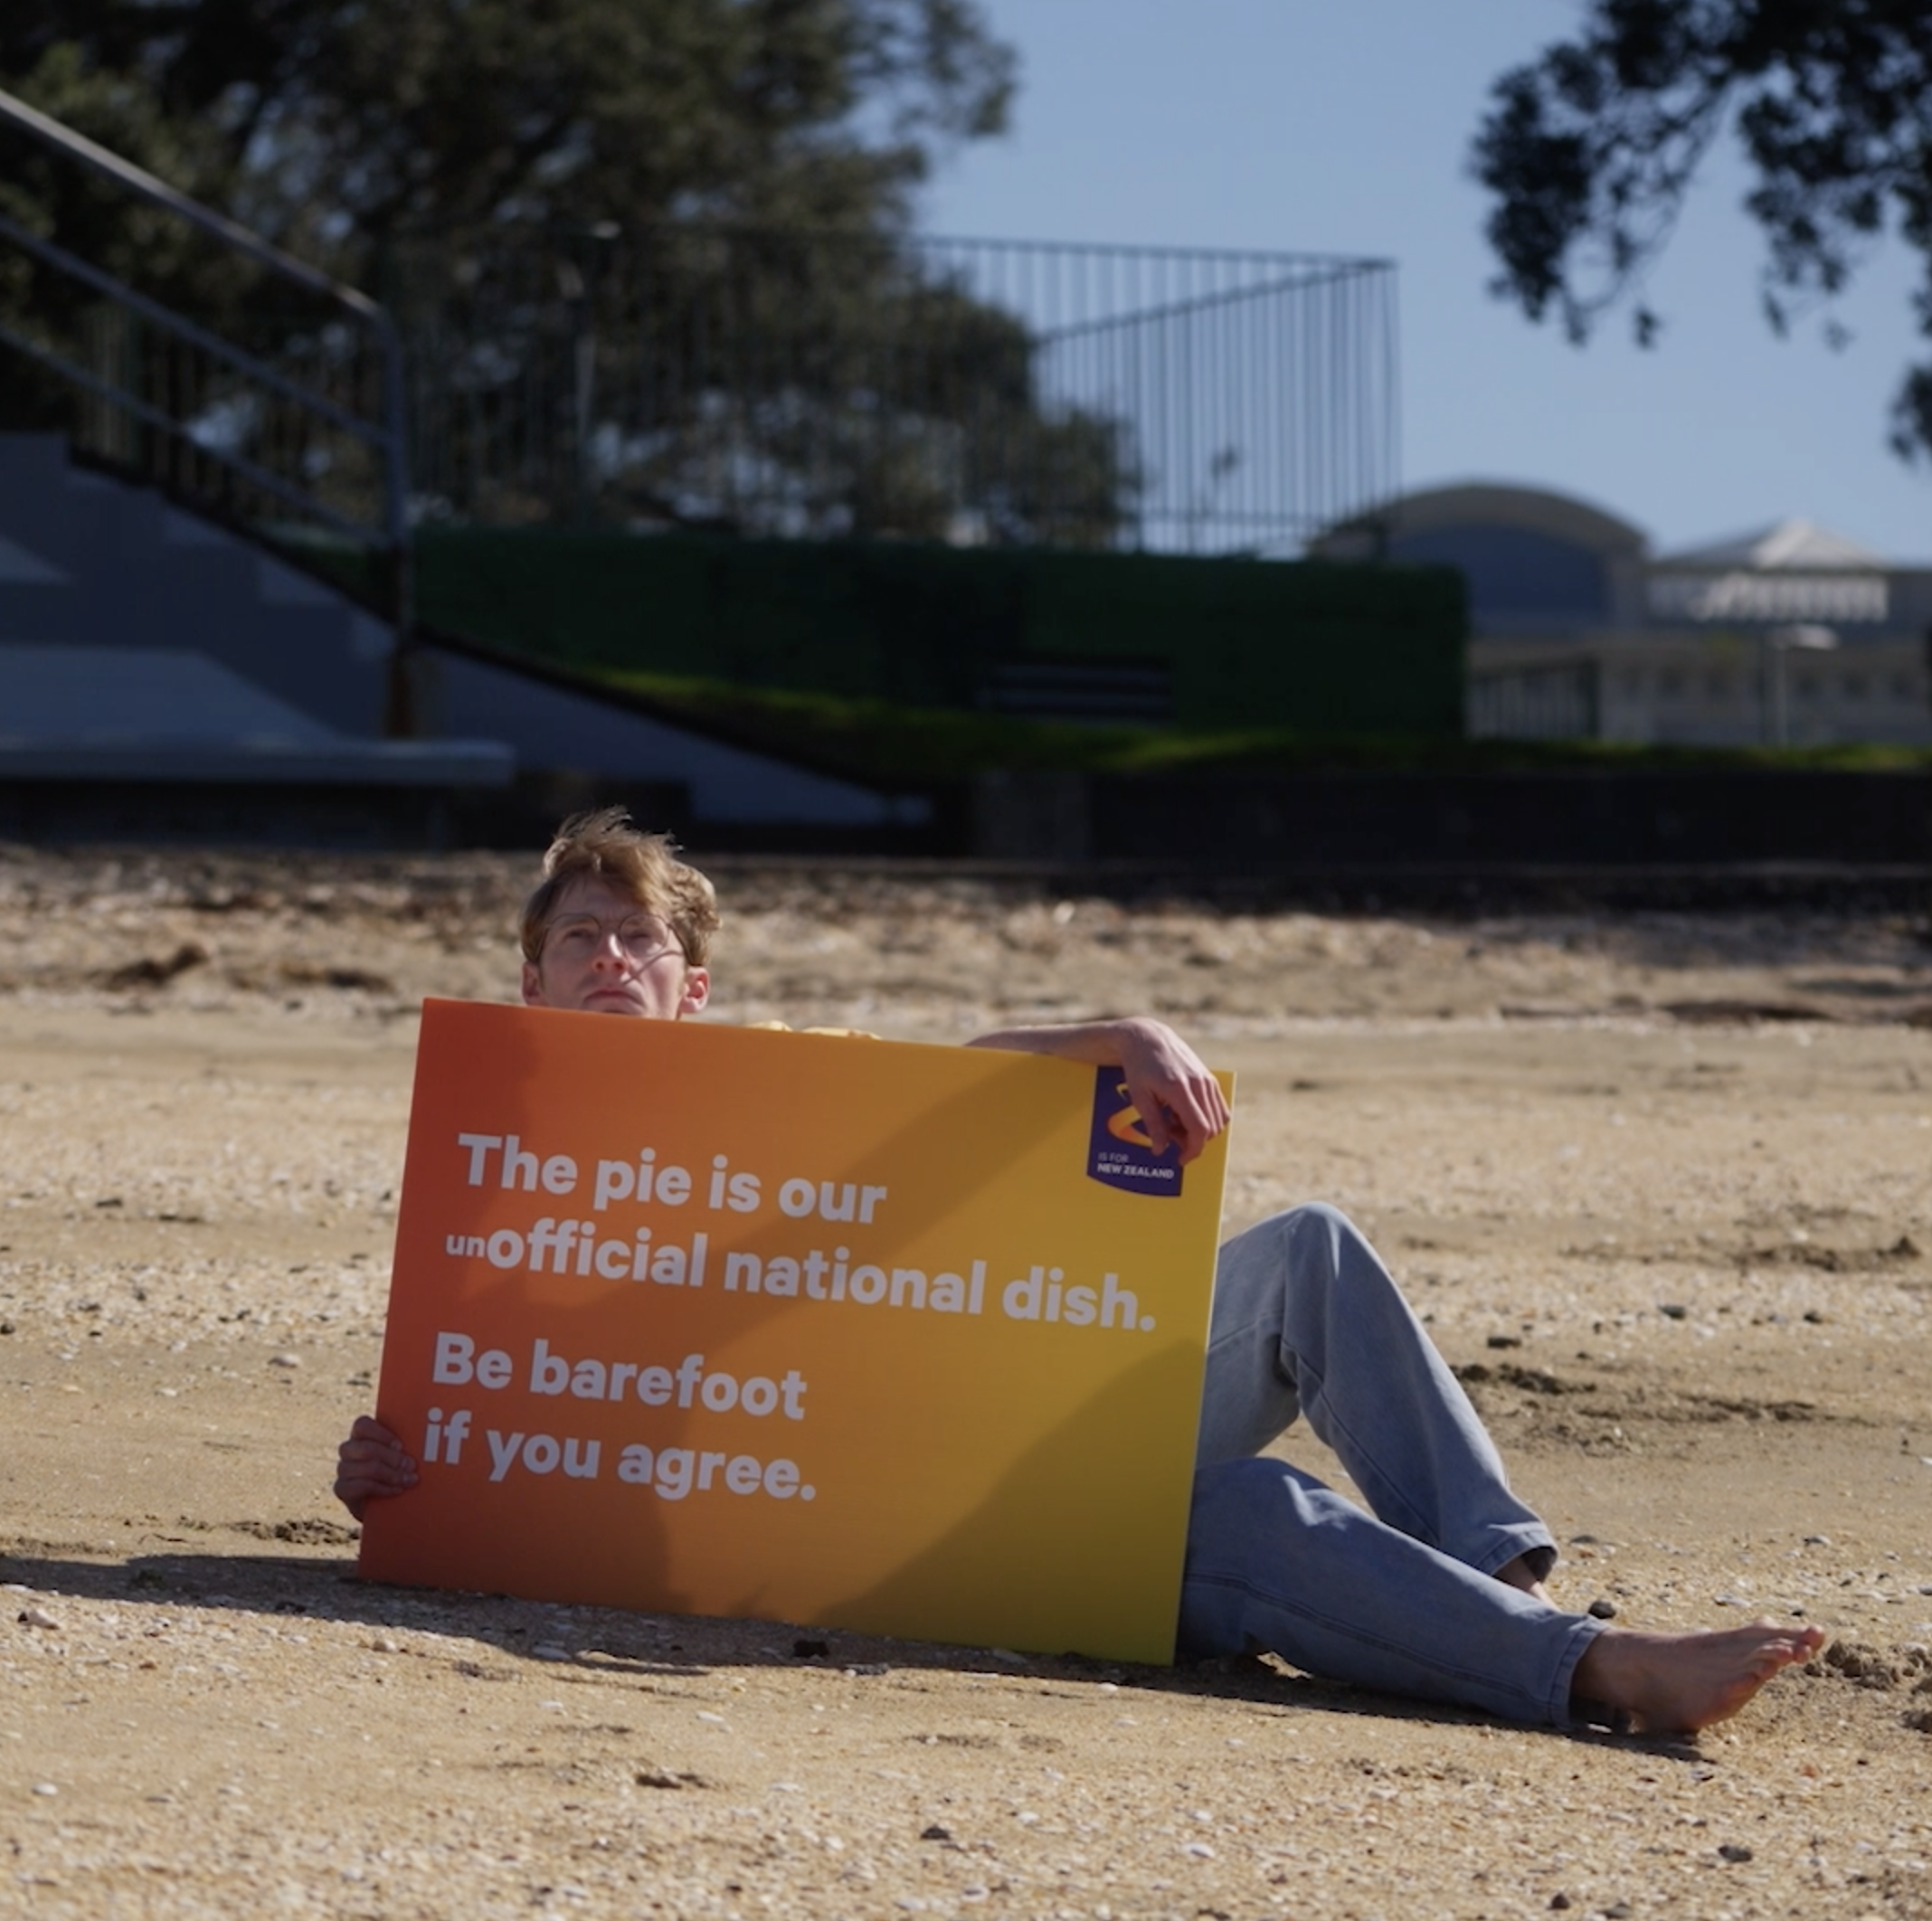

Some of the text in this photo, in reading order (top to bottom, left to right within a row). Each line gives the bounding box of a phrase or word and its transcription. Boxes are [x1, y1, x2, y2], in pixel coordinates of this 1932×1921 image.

[458, 1132, 887, 1224] The pie is our
[1097, 1163, 1175, 1179] NEW ZEALAND
[1098, 1152, 1130, 1163] IS FOR
[445, 1217, 1156, 1332] unofficial national dish.
[432, 1332, 807, 1420] Be barefoot
[423, 1407, 816, 1501] if you agree.
